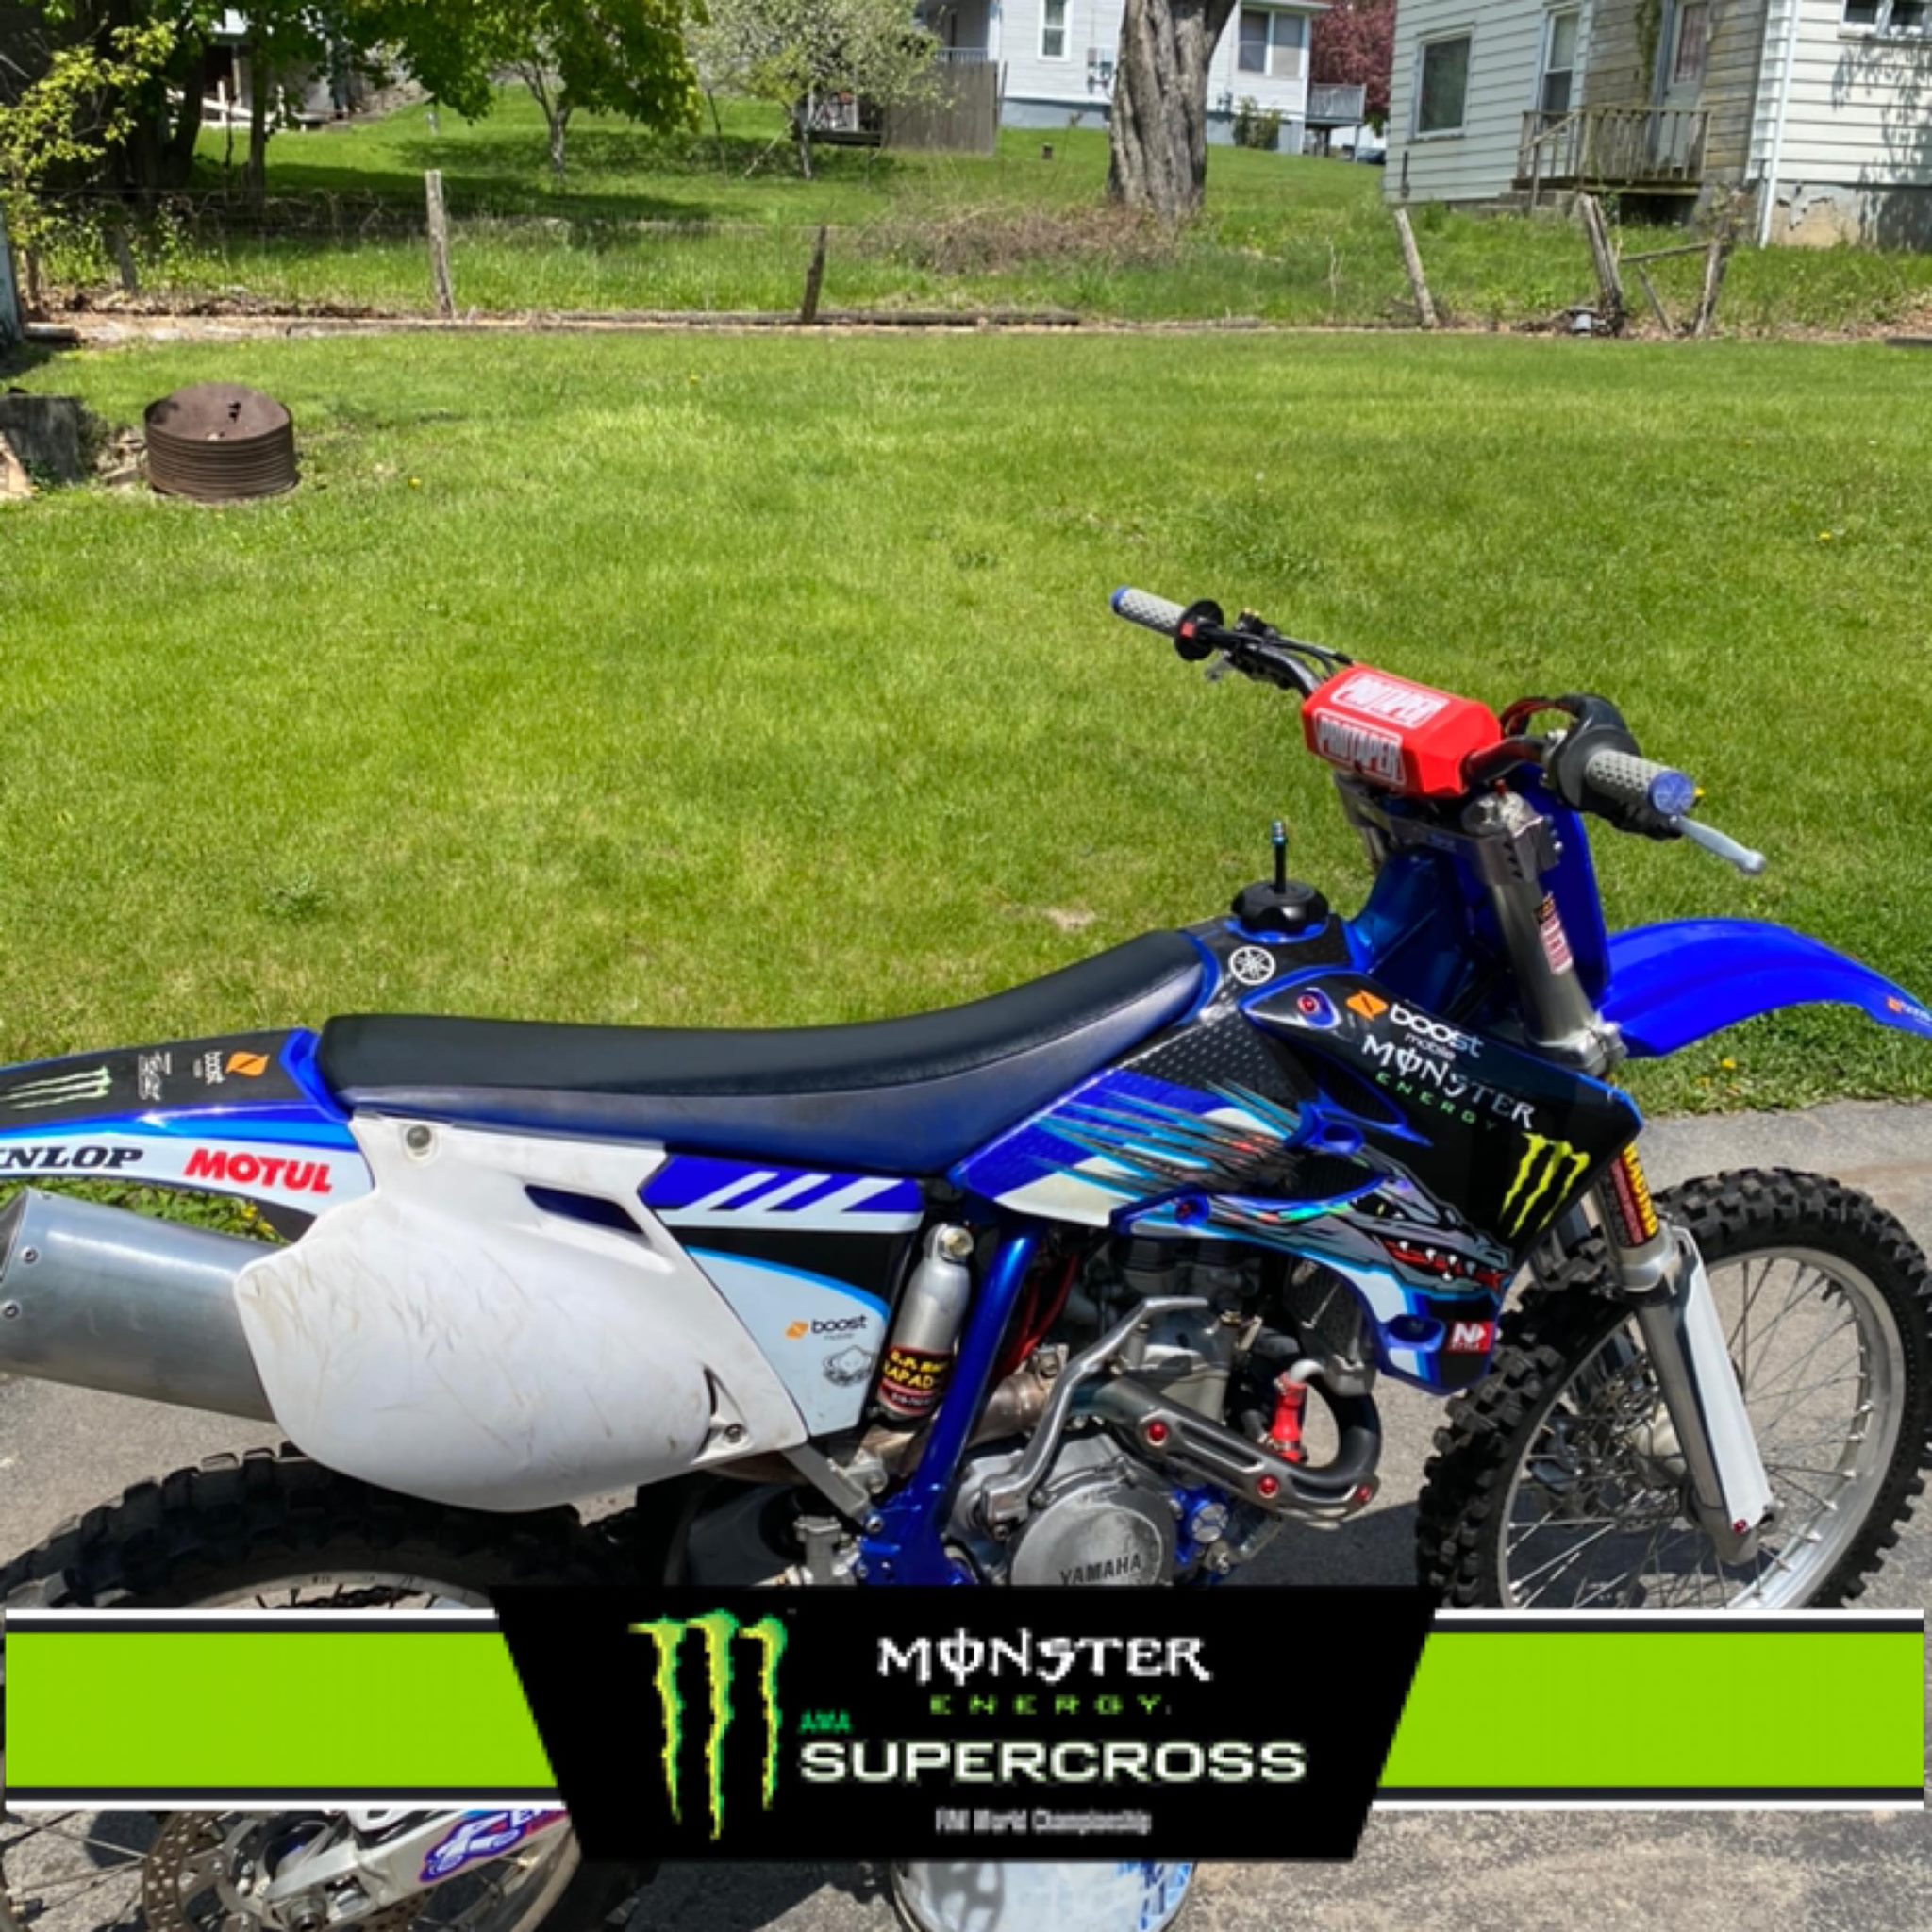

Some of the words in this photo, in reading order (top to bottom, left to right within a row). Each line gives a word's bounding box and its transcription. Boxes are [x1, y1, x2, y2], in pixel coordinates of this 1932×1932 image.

[1316, 714, 1404, 781] PROTAPER
[1390, 1003, 1484, 1058] boost
[1361, 1033, 1536, 1130] MONSTER
[0, 1145, 144, 1169] NLOP
[183, 1148, 333, 1194] MOTUL
[812, 1313, 867, 1334] boost
[1058, 1553, 1141, 1586] YAMAHA
